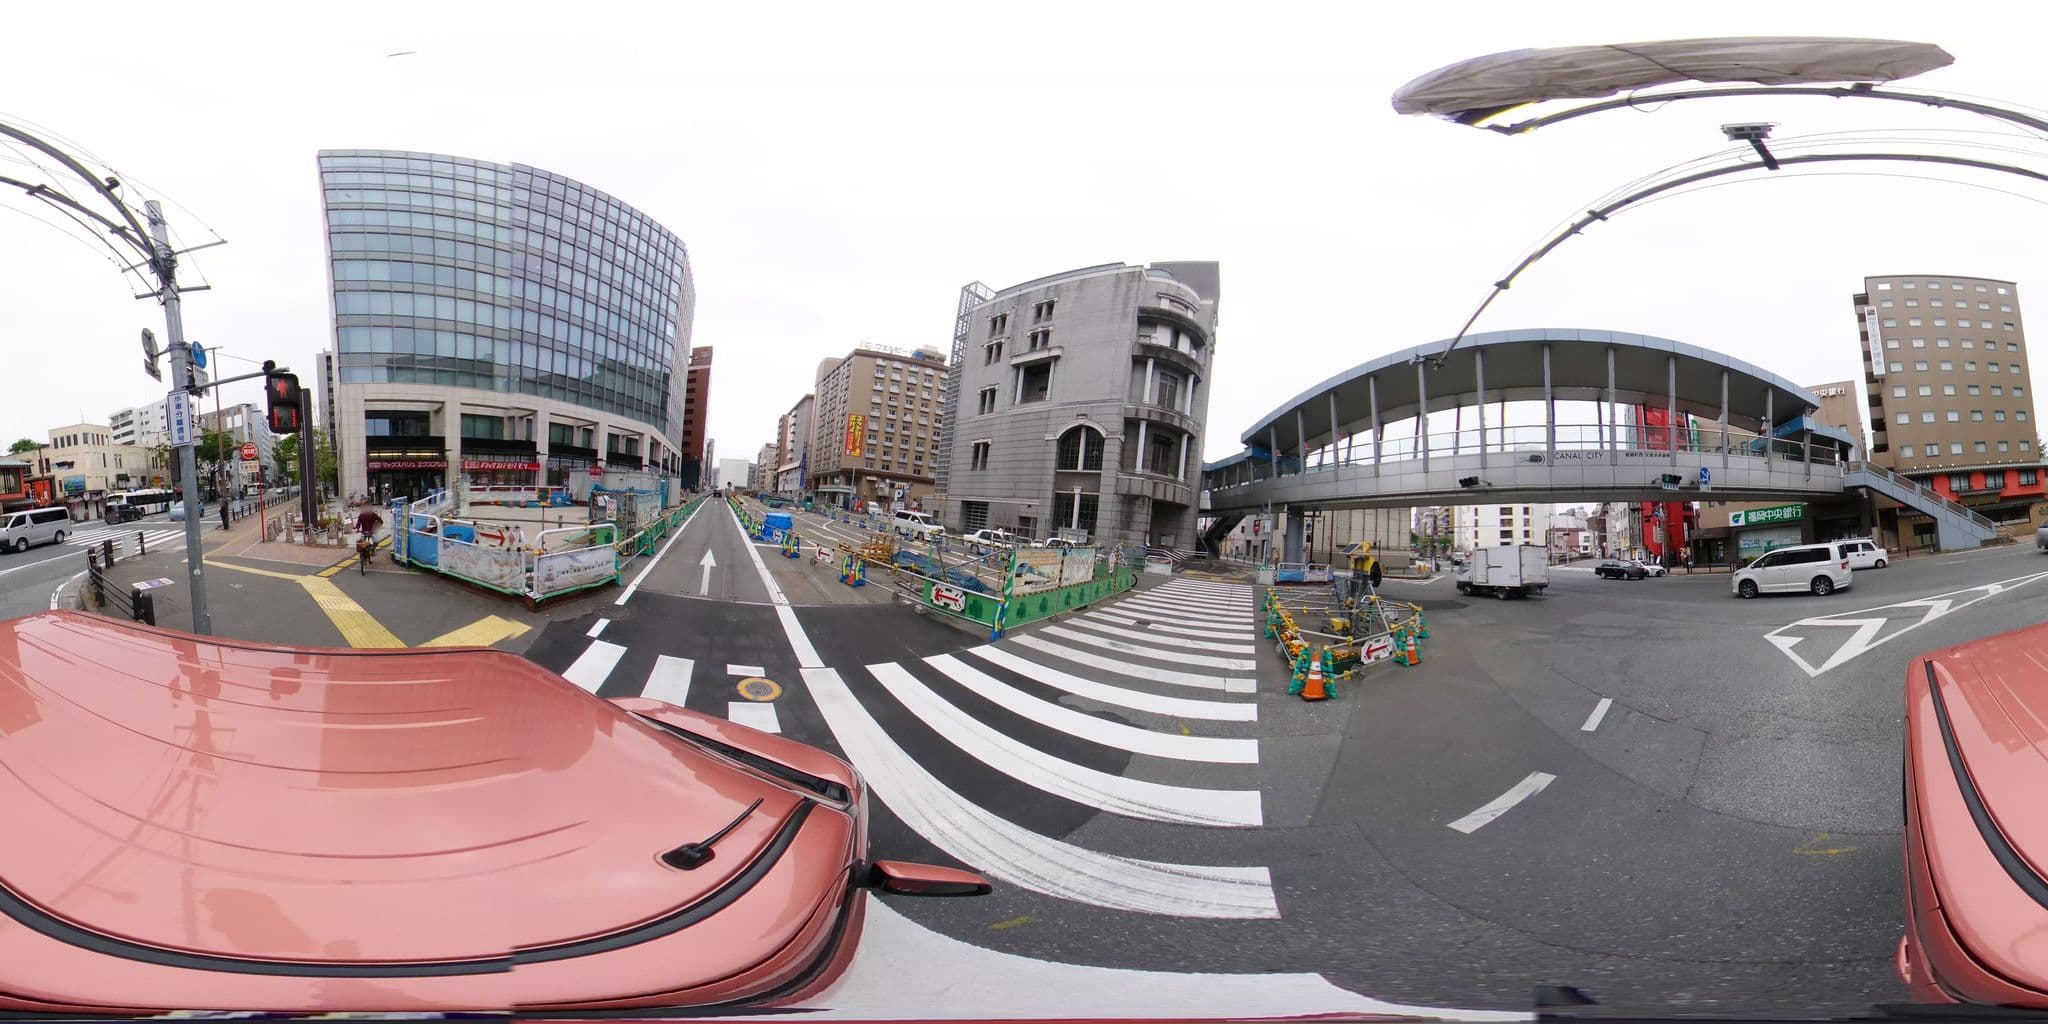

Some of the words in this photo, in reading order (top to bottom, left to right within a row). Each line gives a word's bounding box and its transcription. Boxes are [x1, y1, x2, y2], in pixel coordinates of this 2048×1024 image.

[1554, 452, 1582, 460] CANAL
[1586, 451, 1603, 460] CITY
[1747, 505, 1802, 523] 福岡中央銀行
